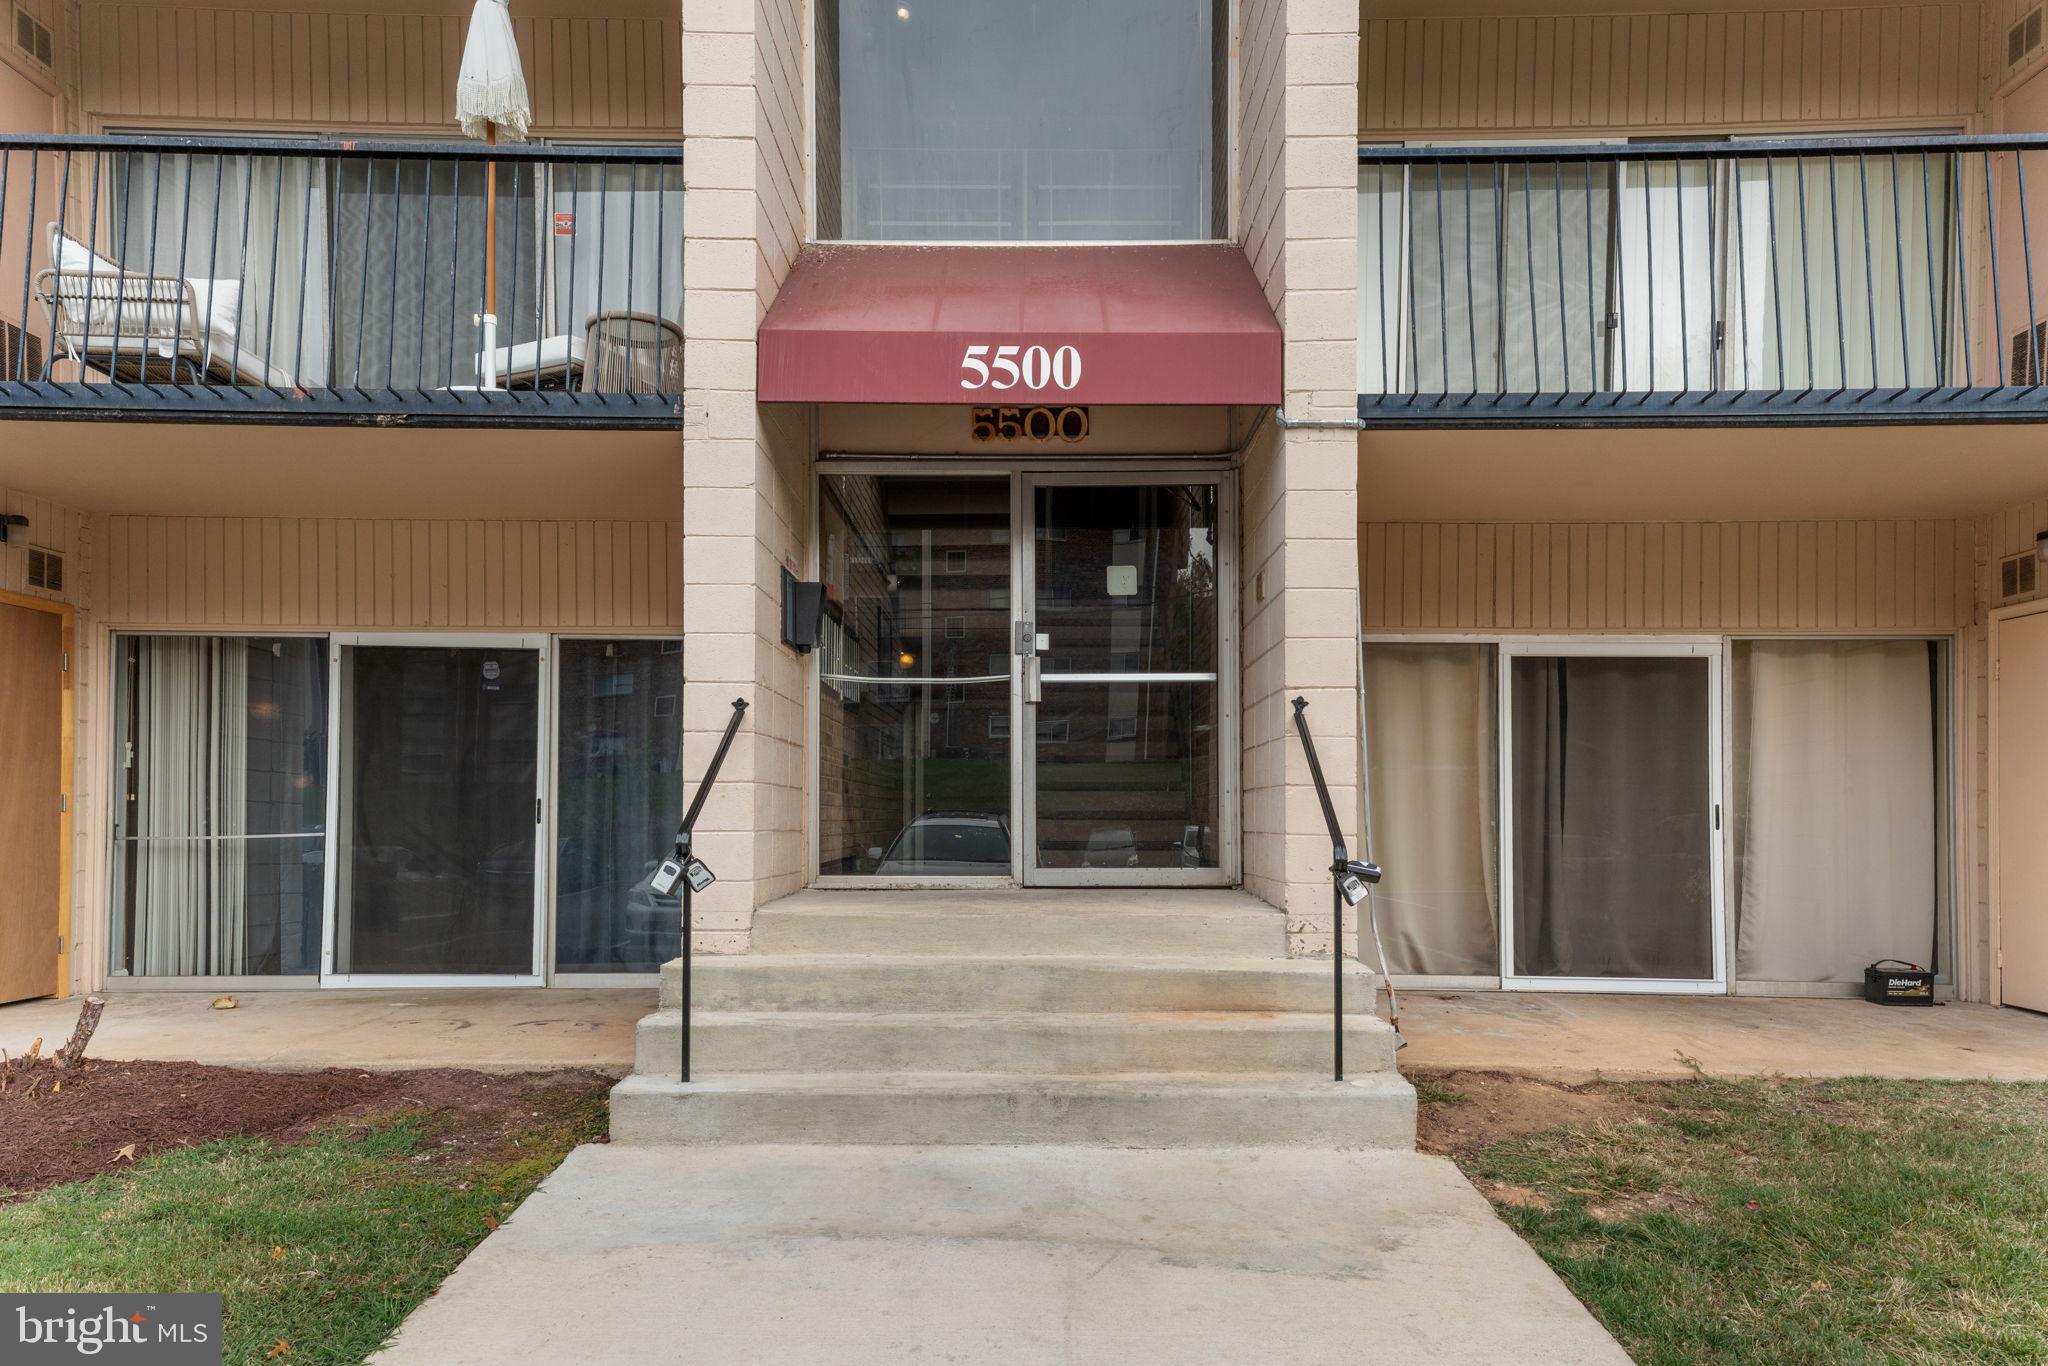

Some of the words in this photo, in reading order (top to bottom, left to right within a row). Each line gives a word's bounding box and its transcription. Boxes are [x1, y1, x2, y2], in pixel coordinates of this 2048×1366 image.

[961, 345, 1082, 390] 5500
[971, 406, 1089, 444] 5500
[1888, 979, 1922, 987] DieHard
